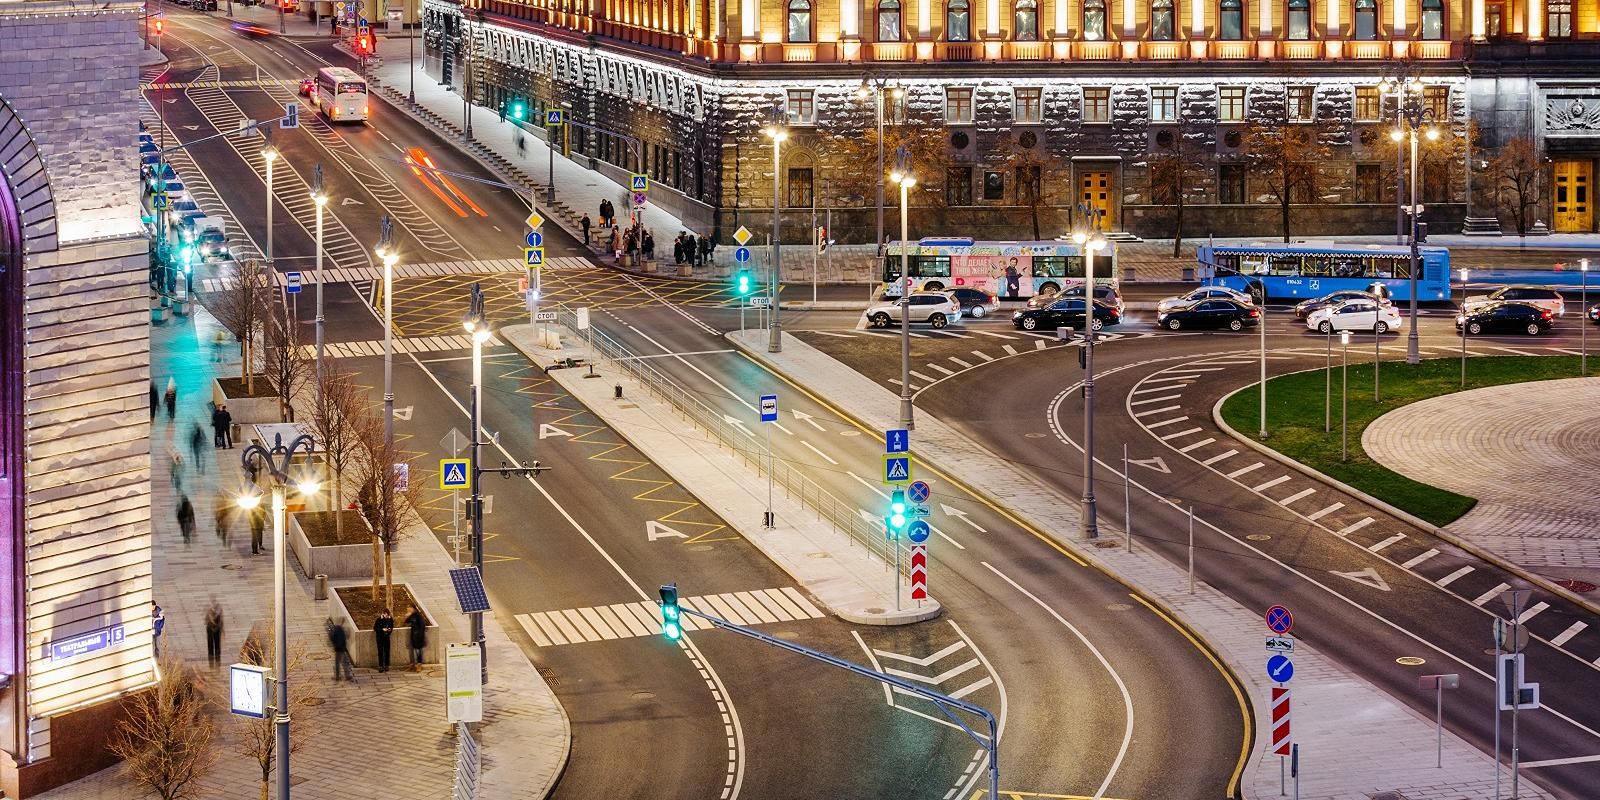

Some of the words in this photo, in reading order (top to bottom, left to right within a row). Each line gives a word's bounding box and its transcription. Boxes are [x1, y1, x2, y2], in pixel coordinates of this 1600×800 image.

[752, 297, 769, 305] СТОП
[537, 312, 555, 320] СТОП
[115, 629, 122, 640] 5
